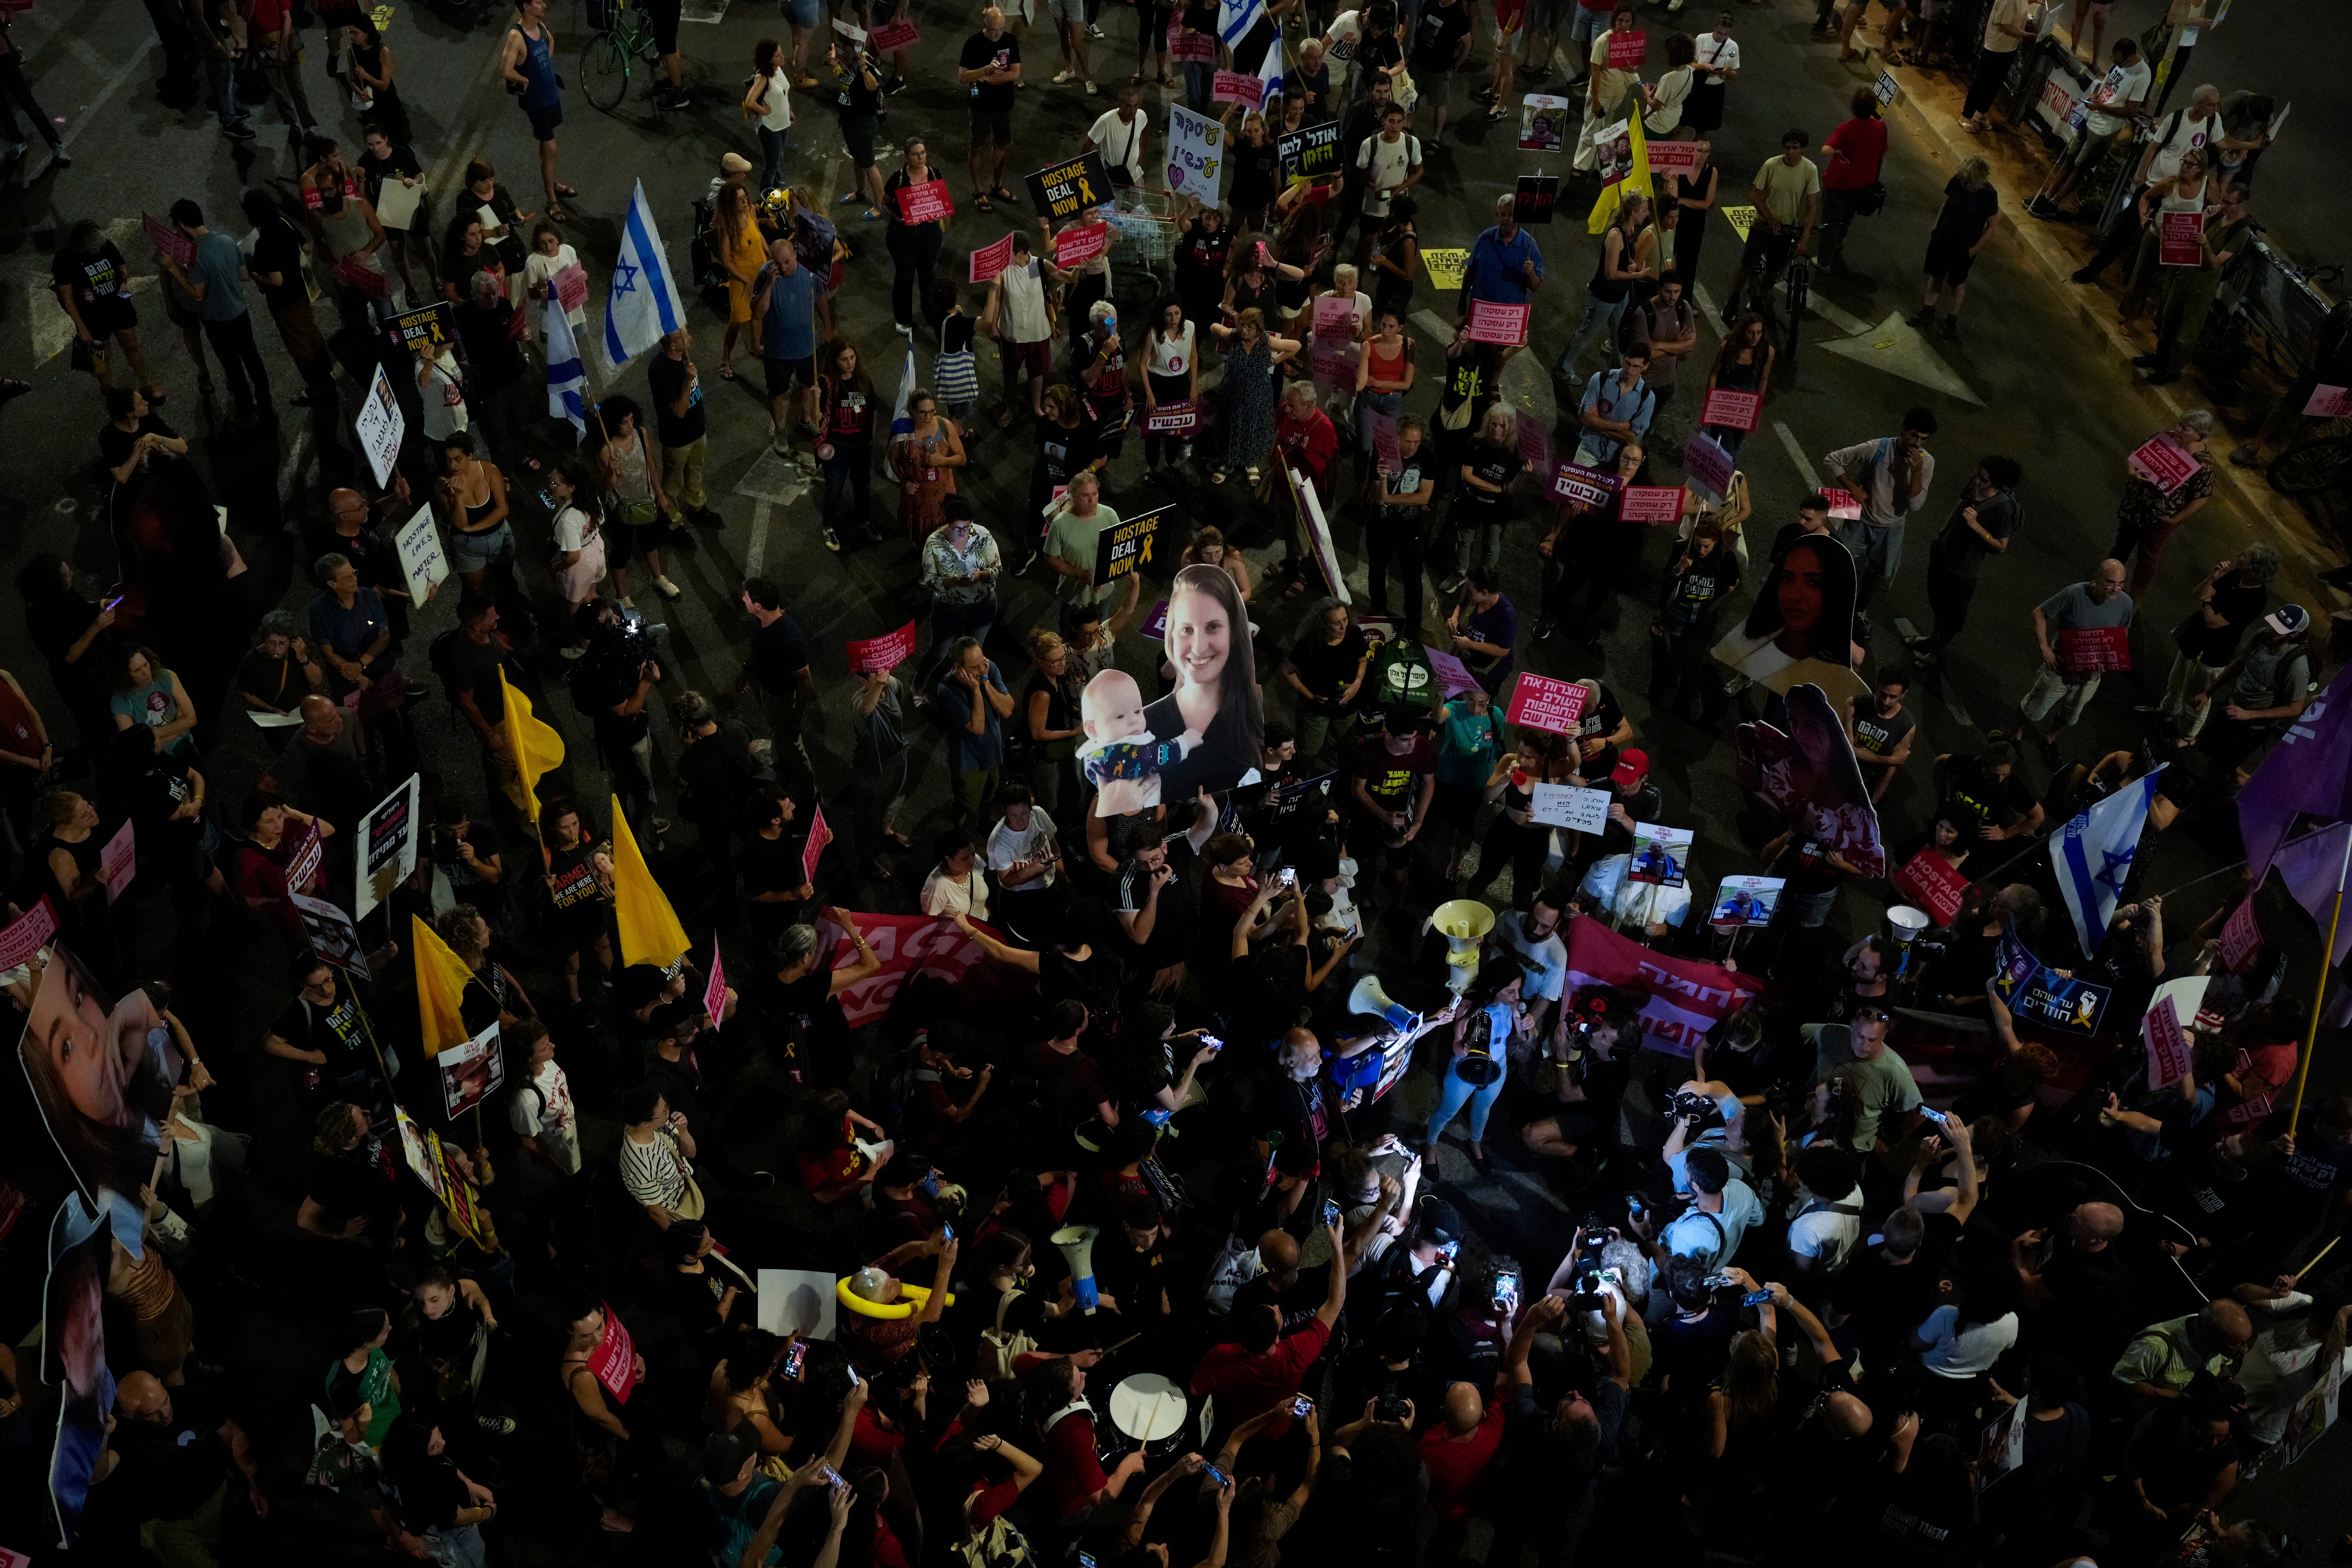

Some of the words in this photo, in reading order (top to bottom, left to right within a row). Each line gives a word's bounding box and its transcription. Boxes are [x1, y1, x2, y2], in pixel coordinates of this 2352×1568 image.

[1610, 39, 1645, 50] HOSTAGE
[1610, 50, 1632, 59] DEAL
[1248, 79, 1261, 89] קול
[1877, 70, 1899, 95] LEAVING
[1174, 111, 1220, 146] עסקה
[1306, 127, 1338, 147] אוזל
[1302, 144, 1333, 173] הזמן
[1041, 161, 1087, 188] HOSTAGE
[907, 191, 928, 199] מחזירה
[1046, 184, 1074, 201] DEAL
[934, 202, 943, 210] רק
[1052, 196, 1078, 217] NOW
[913, 214, 928, 222] חיים
[1002, 239, 1009, 248] רק
[1059, 237, 1086, 251] דורשות
[1088, 233, 1104, 242] נשים
[980, 244, 1001, 259] עסקה!
[1002, 250, 1009, 259] רק
[1081, 242, 1101, 253] עסקה
[979, 254, 1001, 269] עסקה!
[1481, 306, 1507, 315] עסקה!
[400, 309, 439, 329] HOSTAGE
[1479, 319, 1505, 328] עסקה!
[403, 326, 427, 340] DEAL
[1476, 331, 1502, 339] עסקה!
[407, 336, 430, 351] NOW
[1313, 357, 1355, 373] HOSTAGE
[1314, 366, 1339, 377] DEAL
[1716, 392, 1740, 401] עסקה!
[1713, 404, 1738, 412] עסקה!
[1151, 416, 1193, 427] עכשיו
[1710, 415, 1735, 424] עסקה!
[1689, 444, 1729, 479] HOSTAGE
[2155, 442, 2182, 468] שהפקיר
[1561, 464, 1585, 477] העסקה
[1686, 454, 1712, 477] DEAL
[2179, 465, 2188, 475] מי
[1559, 471, 1584, 483] המלחמה
[1585, 470, 1596, 479] את
[1598, 474, 1615, 485] לקבל
[1560, 480, 1605, 504] עכשיו
[403, 515, 431, 550] HOSTAGE
[1114, 516, 1160, 544] HOSTAGE
[412, 533, 433, 557] LIVES
[1111, 539, 1136, 561] DEAL
[412, 550, 440, 581] MATTER
[1108, 555, 1135, 578] NOW
[869, 633, 897, 646] לחימה
[895, 634, 905, 643] לא
[861, 641, 893, 653] מחזירה
[895, 648, 906, 656] רק
[865, 654, 894, 667] עסקה
[1438, 663, 1457, 672] STOP
[1389, 669, 1400, 677] אלון
[1411, 672, 1425, 680] סופר
[1523, 676, 1542, 688] את
[1545, 681, 1586, 699] עוצרות
[1542, 691, 1583, 709] העולם
[1524, 698, 1578, 718] החטופות
[1522, 710, 1541, 723] שם
[1857, 720, 1872, 735] הם
[1869, 726, 1889, 742] למה
[397, 822, 409, 840] עד
[1802, 847, 1812, 855] THEM
[290, 845, 321, 889] עכשיו
[1632, 860, 1647, 868] BRING
[565, 884, 577, 896] ARE
[577, 876, 593, 890] HERE
[1913, 856, 1964, 905] HOSTAGE
[558, 896, 577, 910] FOR
[575, 882, 598, 902] YOU!
[1905, 865, 1935, 898] DEAL
[1936, 895, 1956, 916] NOW
[26, 907, 41, 922] רק
[32, 919, 46, 933] רק
[37, 927, 51, 944] רק
[2032, 987, 2057, 1004] שהם
[2058, 997, 2074, 1008] עד
[2022, 995, 2071, 1021] חוזרים
[449, 1089, 466, 1103] BRING
[450, 1098, 461, 1109] HER
[1225, 1269, 1248, 1280] Ach
[1917, 1520, 1949, 1541] THEM
